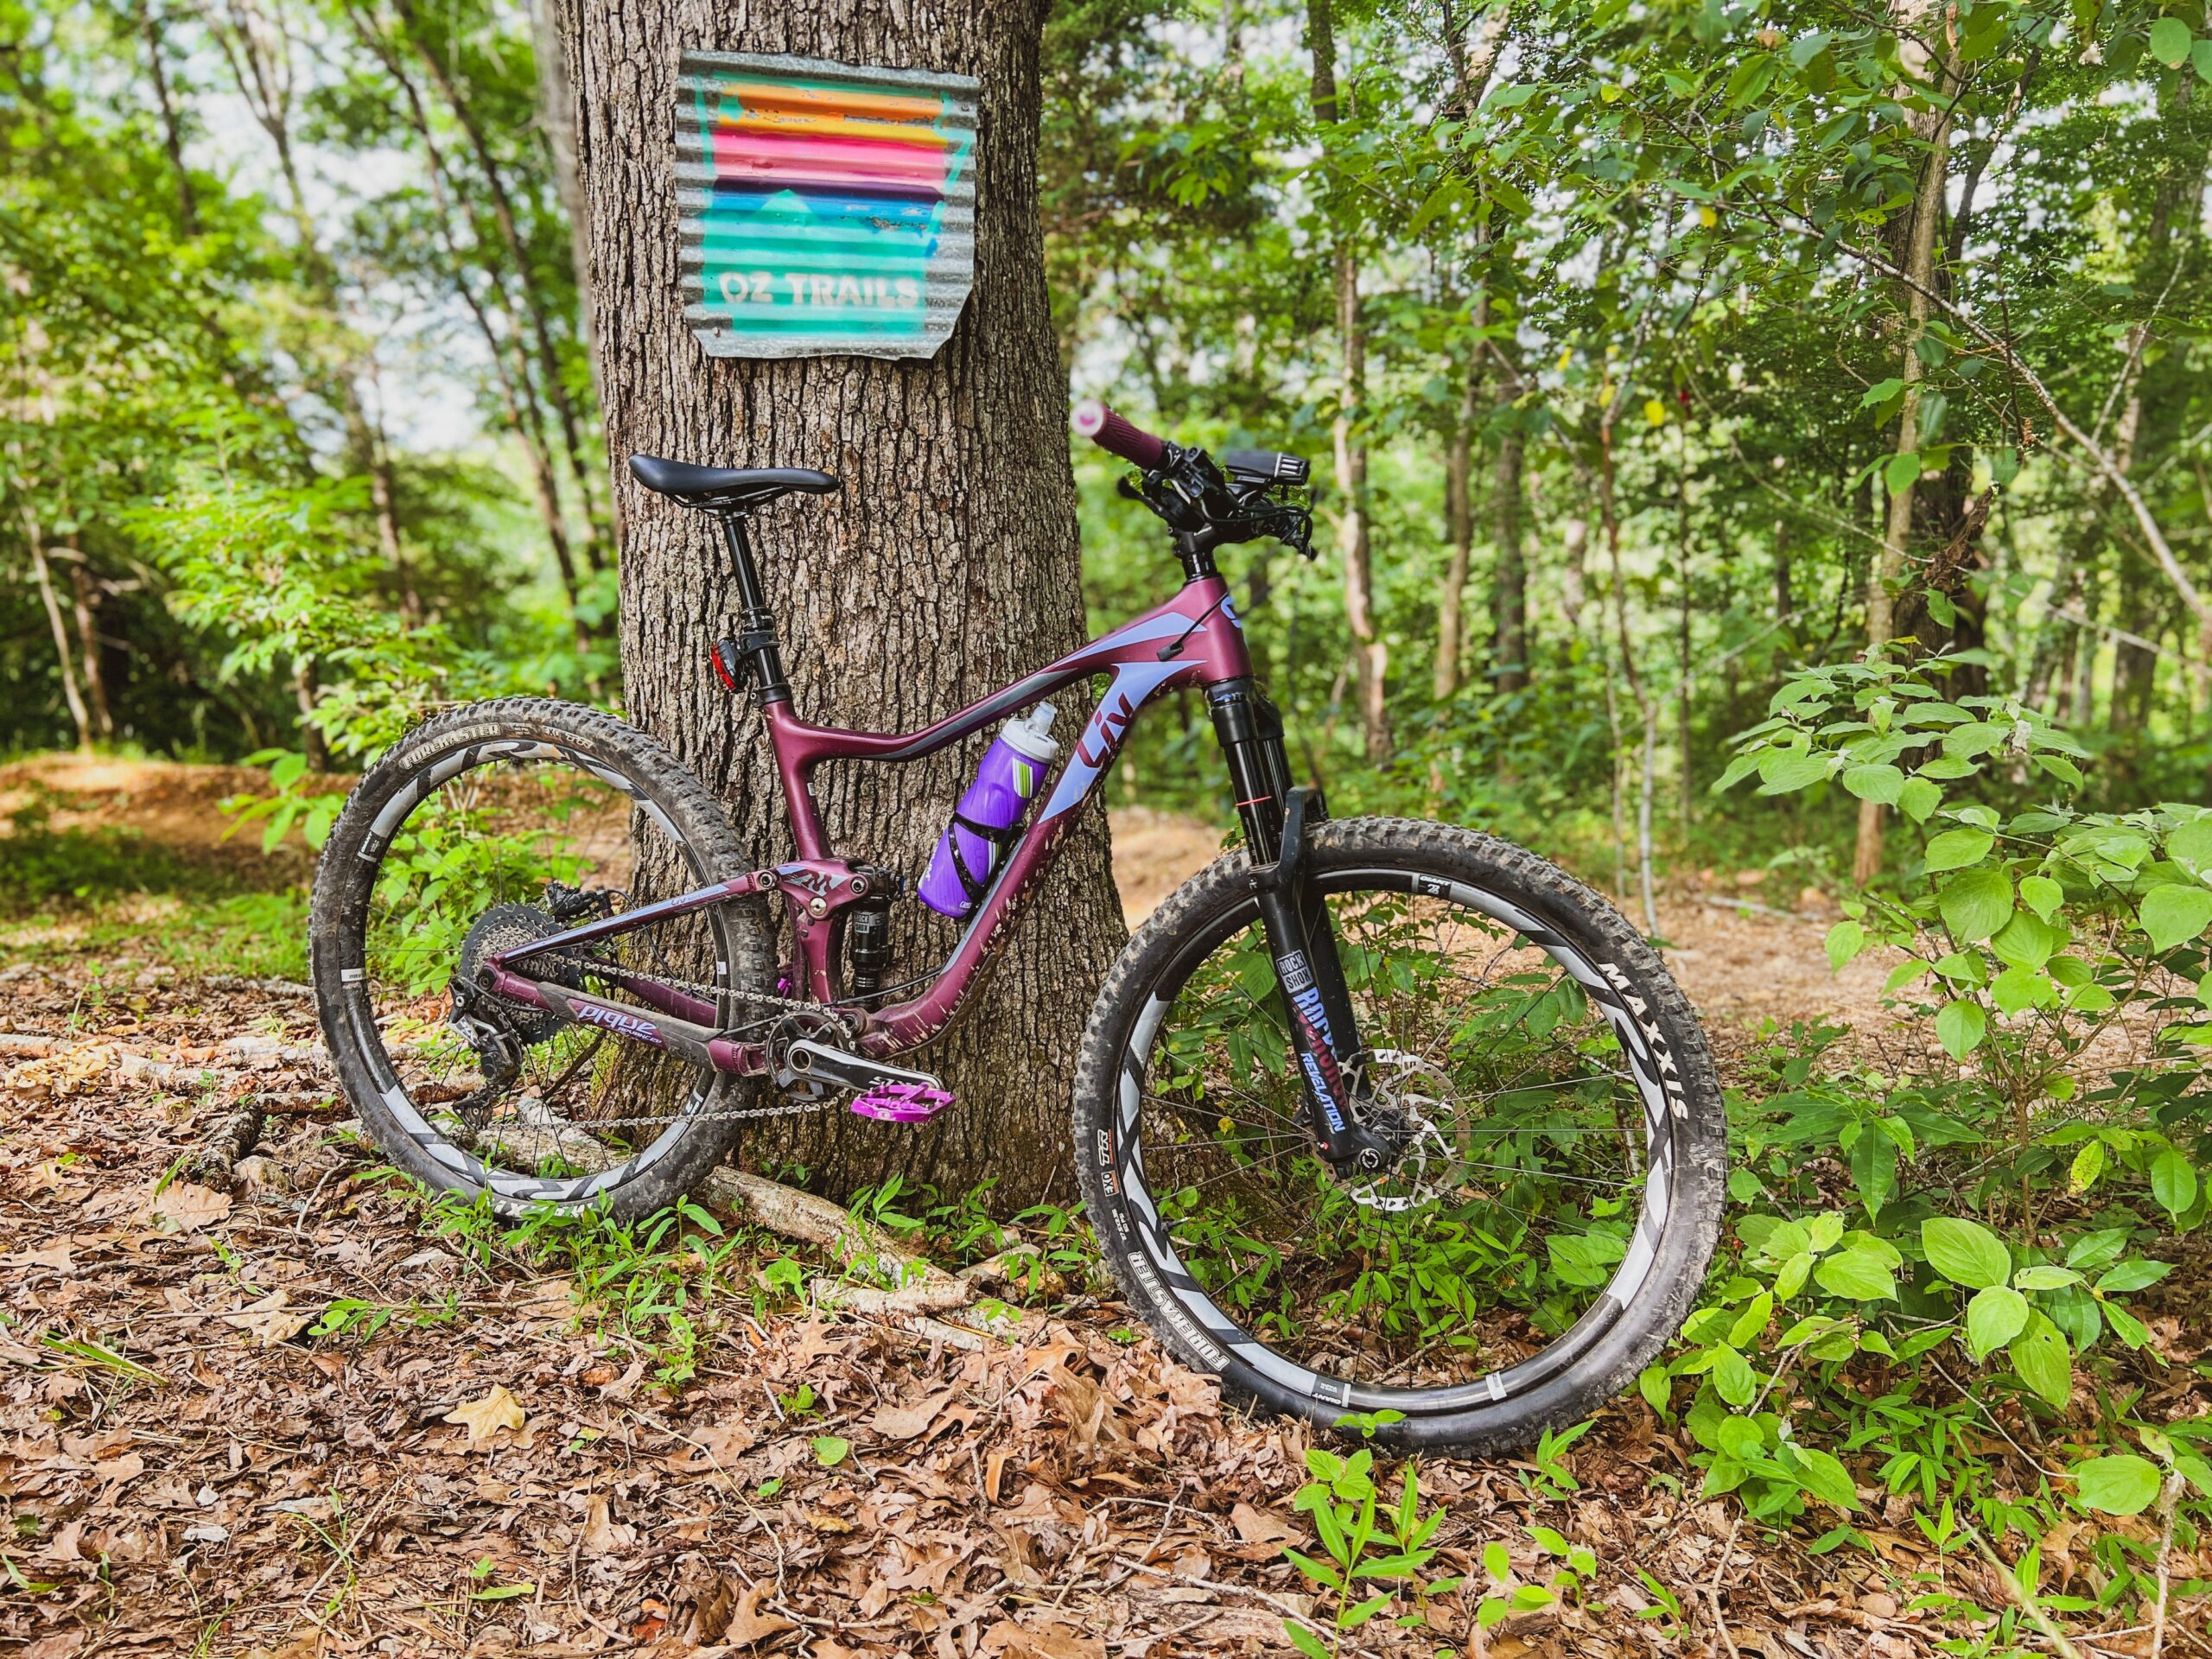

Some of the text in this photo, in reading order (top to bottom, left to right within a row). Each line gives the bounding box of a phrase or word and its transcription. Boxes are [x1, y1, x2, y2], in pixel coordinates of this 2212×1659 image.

[719, 271, 918, 307] OZ TRAILS
[1420, 875, 1452, 886] GIANT
[1280, 950, 1306, 975] ROCK
[1287, 968, 1311, 990] SHOX
[1599, 963, 1689, 1121] MAXXIS
[1300, 1051, 1346, 1135] REVELATION
[1103, 1173, 1115, 1195] EXO
[1128, 1250, 1230, 1371] FOREKASTER
[1312, 1392, 1342, 1406] GIANT
